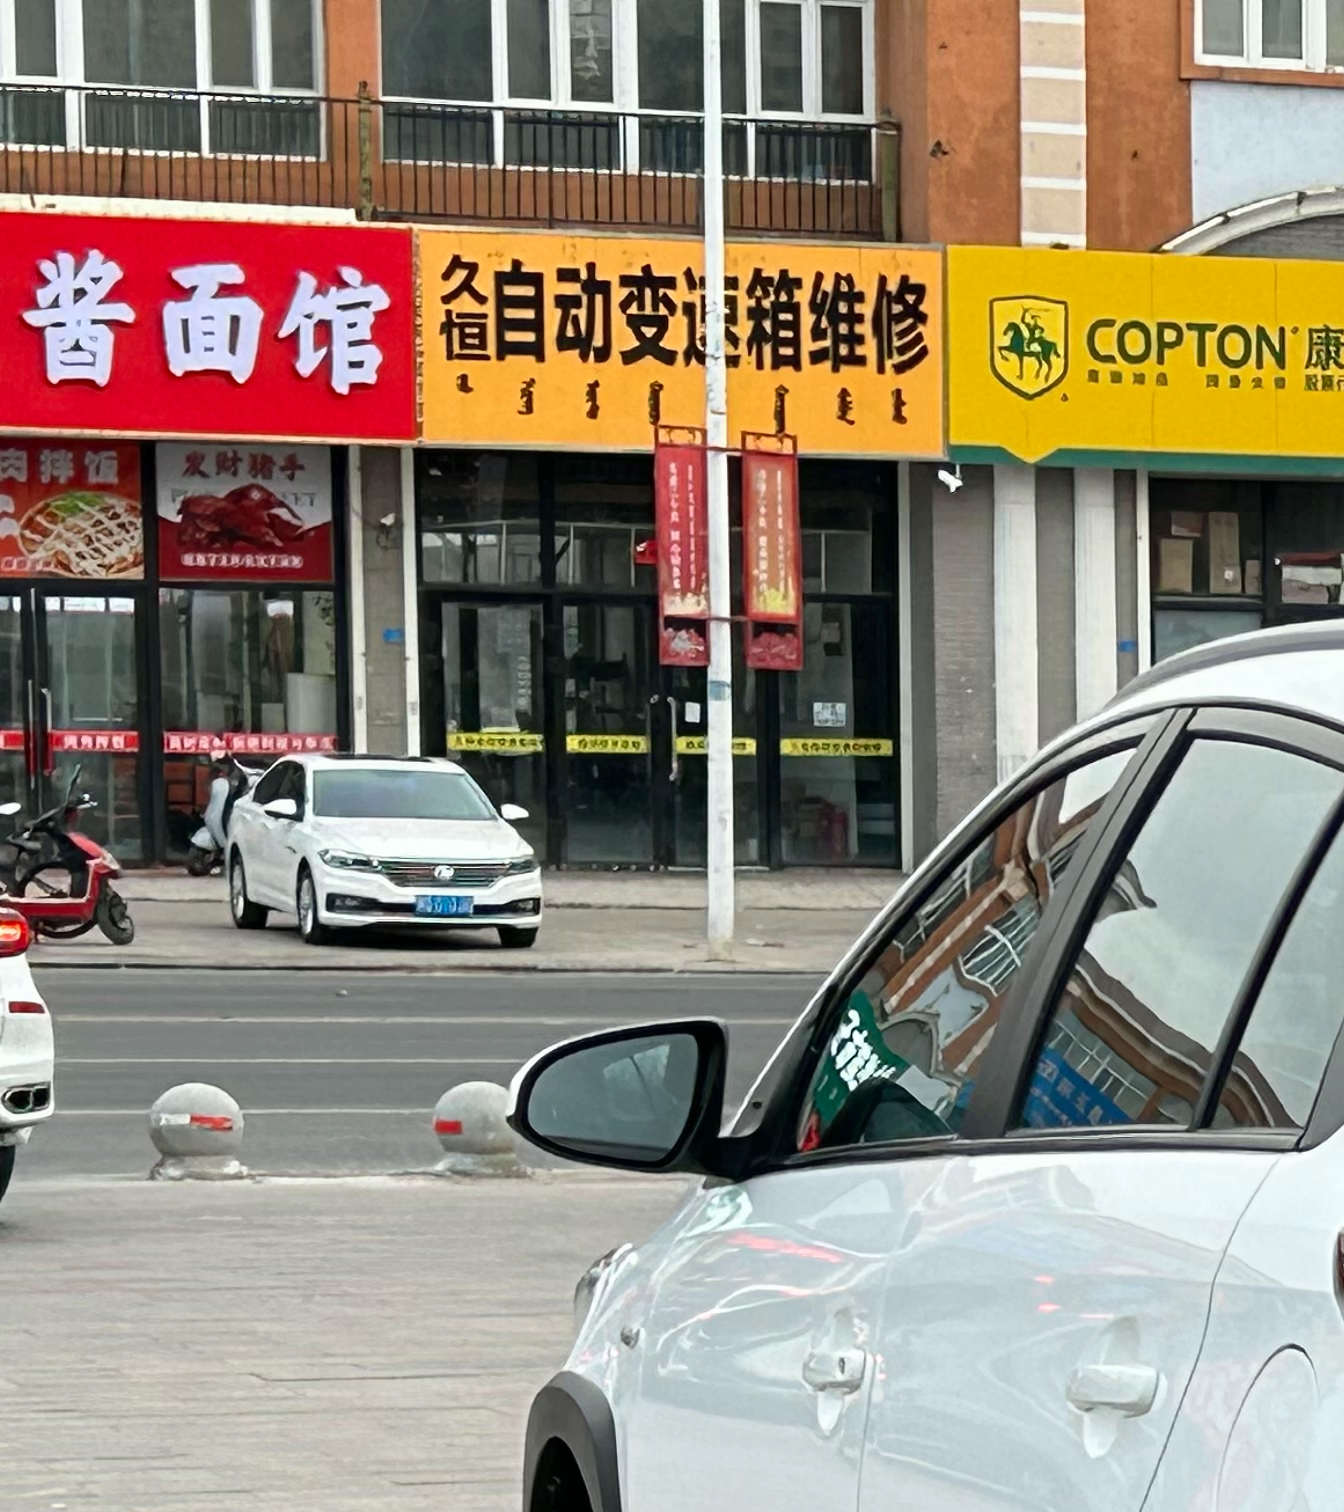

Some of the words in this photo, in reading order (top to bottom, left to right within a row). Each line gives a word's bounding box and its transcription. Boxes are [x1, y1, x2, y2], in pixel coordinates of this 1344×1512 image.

[22, 249, 391, 396] 酱面馆
[440, 254, 491, 362] 久恒
[494, 258, 930, 375] 自动变速箱维修
[1086, 318, 1286, 371] COPTON
